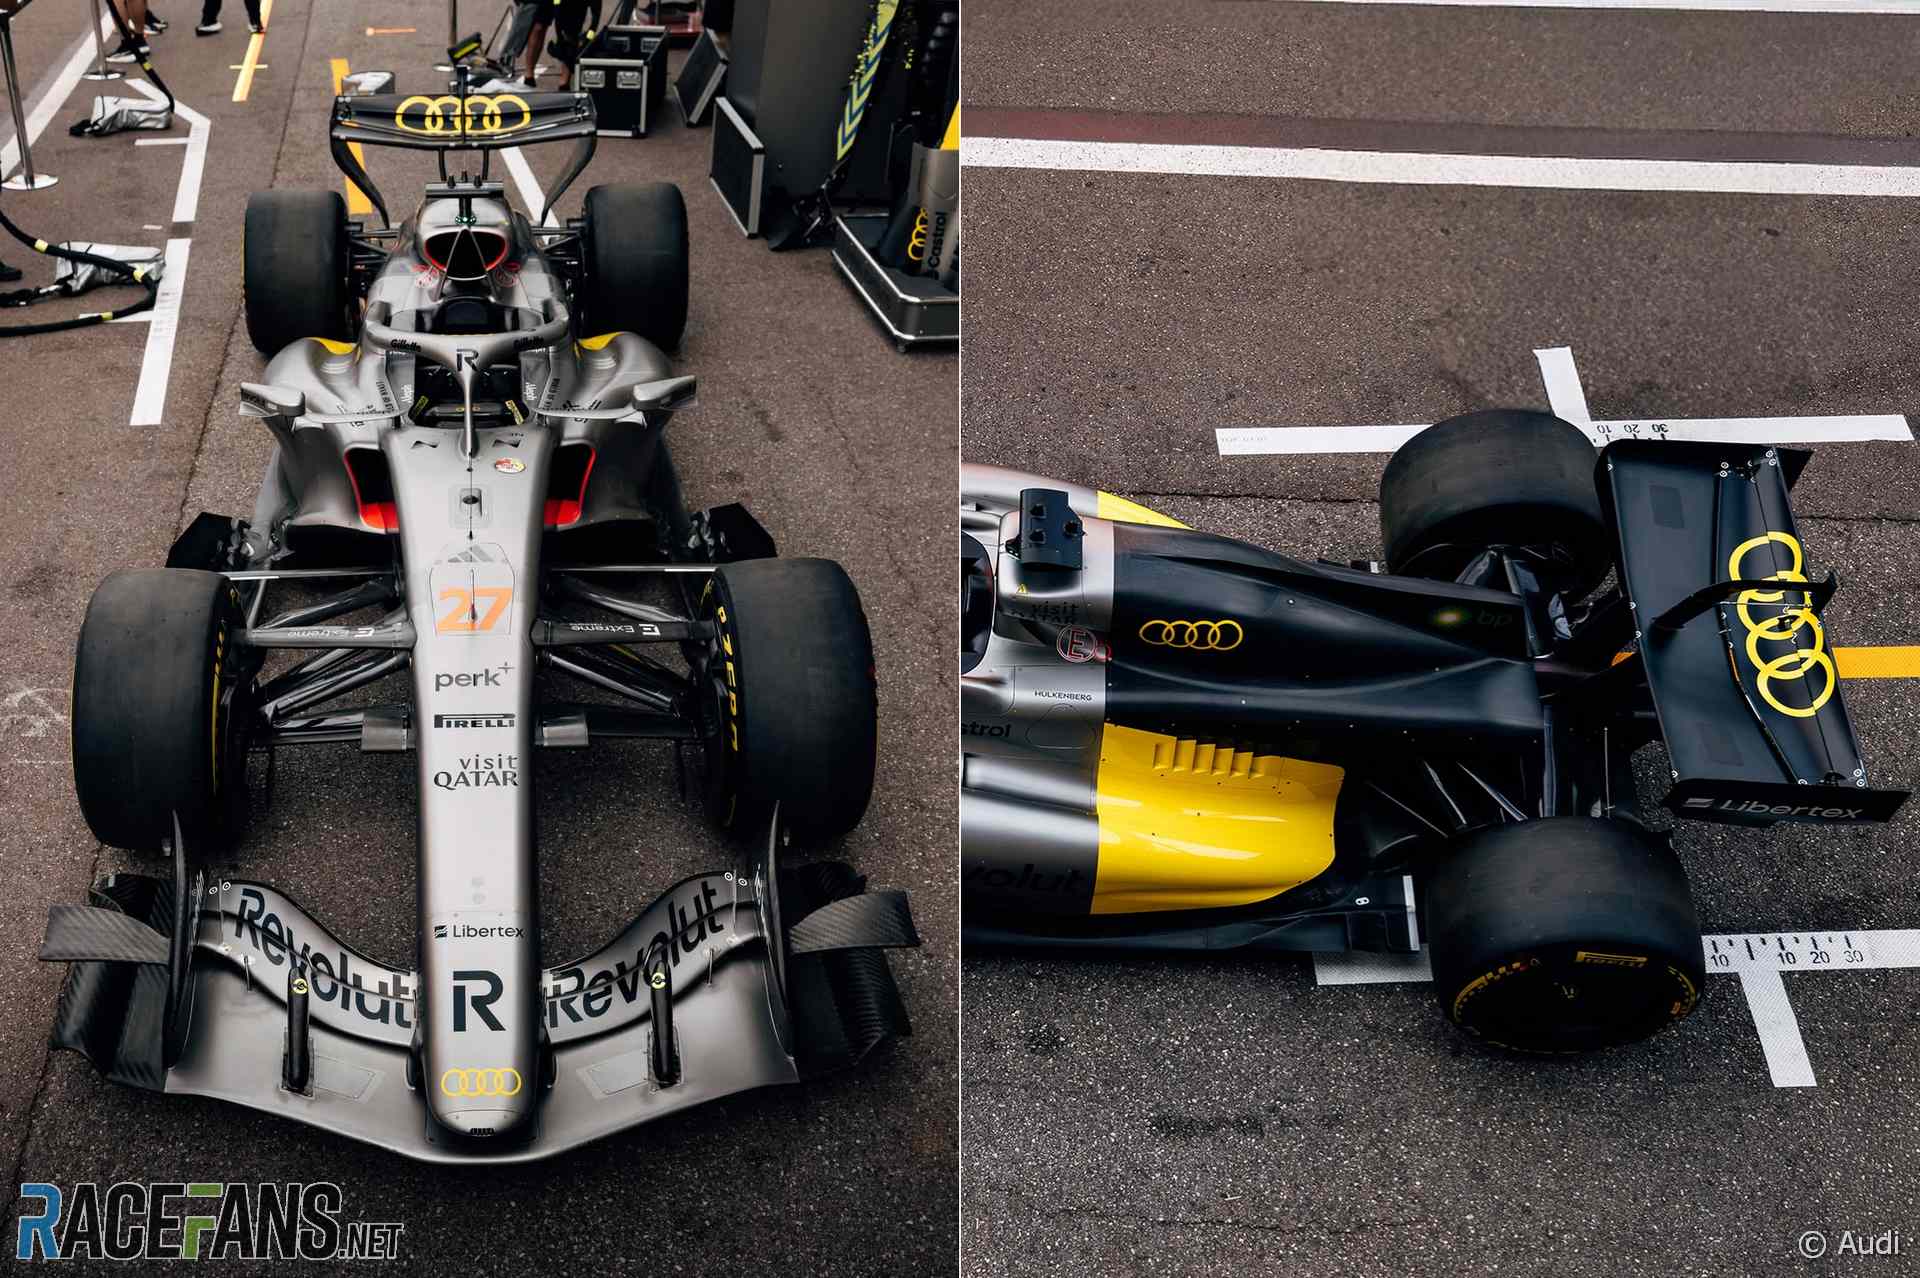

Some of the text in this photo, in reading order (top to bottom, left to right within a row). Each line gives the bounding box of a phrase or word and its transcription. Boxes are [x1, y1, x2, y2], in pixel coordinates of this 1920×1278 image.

[928, 211, 946, 268] Castrol
[1597, 423, 1669, 433] 10 20 30
[436, 587, 513, 633] 27
[434, 713, 516, 728] PIRELLI
[459, 753, 518, 769] visit
[433, 771, 519, 790] QATAR
[1719, 800, 1863, 818] Libertex
[452, 924, 524, 938] Libertex
[235, 888, 412, 1028] Revolut
[548, 880, 725, 1029] Revolut
[1711, 950, 1864, 967] 10 10 20 30
[453, 970, 506, 1032] R
